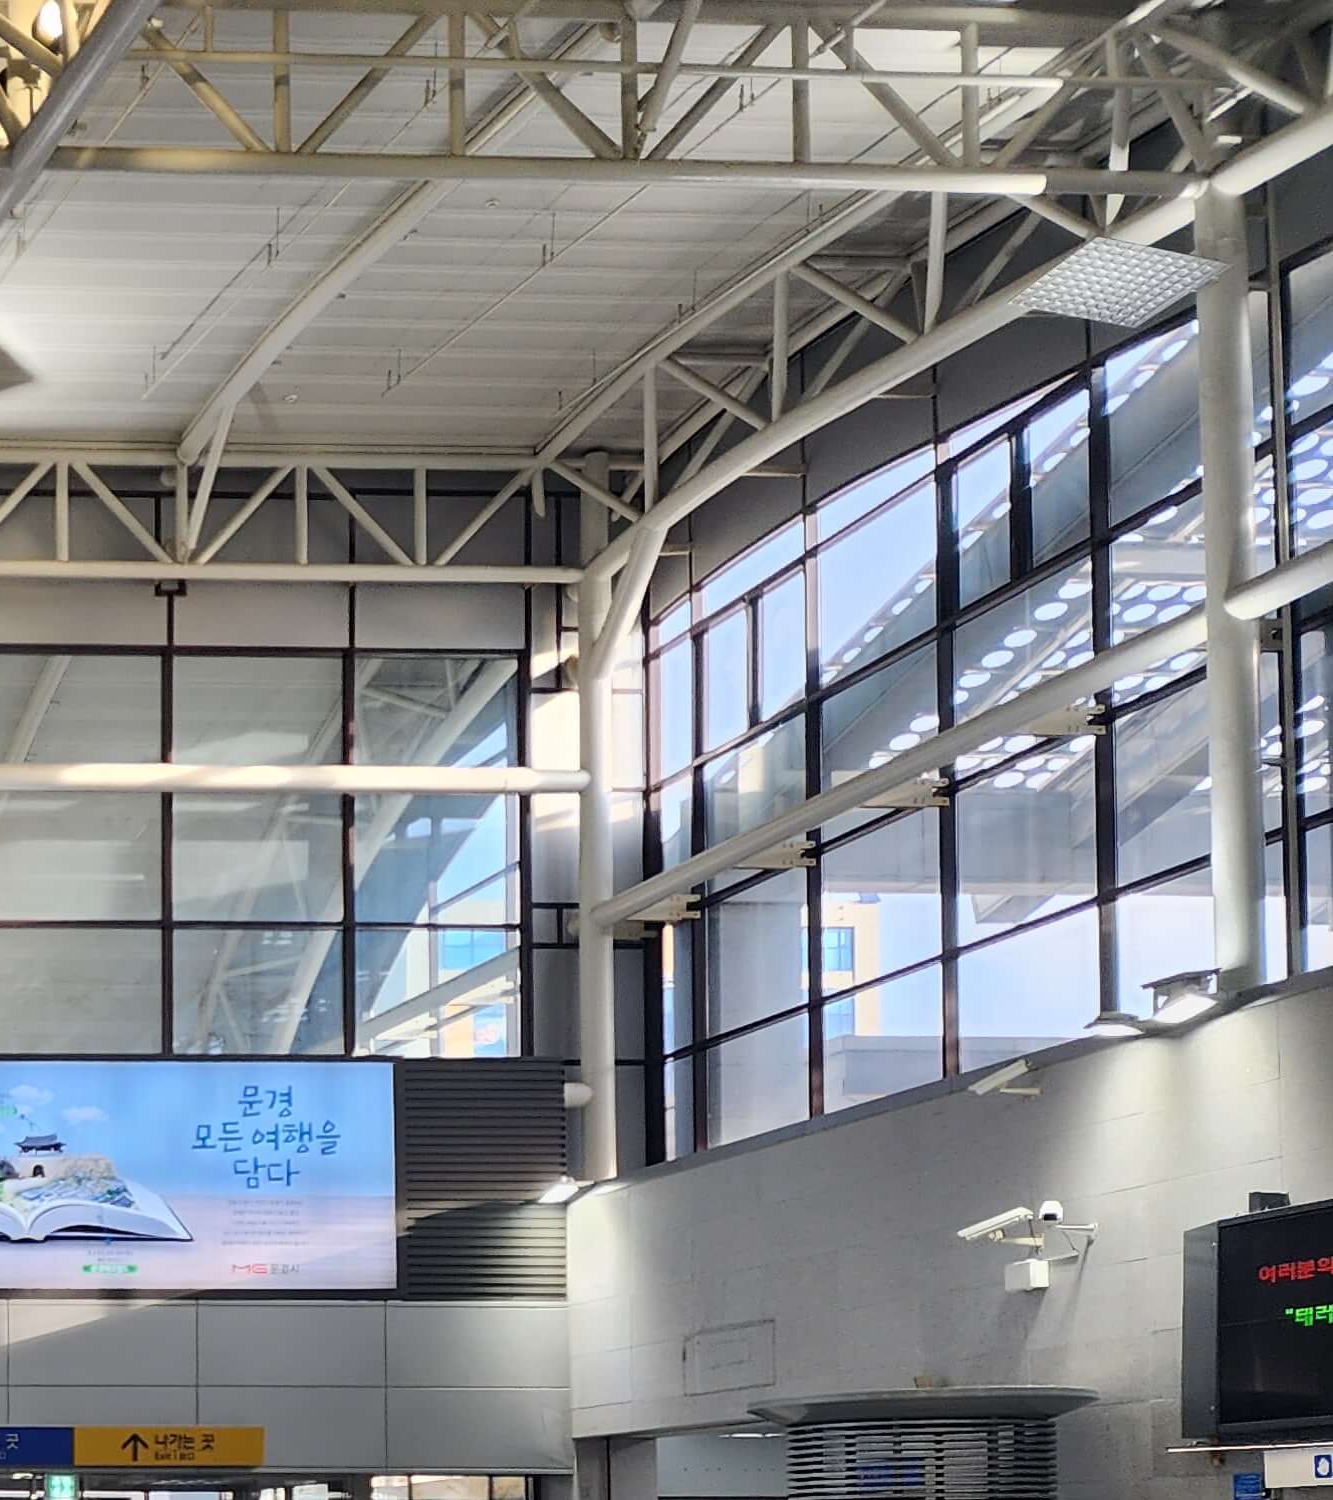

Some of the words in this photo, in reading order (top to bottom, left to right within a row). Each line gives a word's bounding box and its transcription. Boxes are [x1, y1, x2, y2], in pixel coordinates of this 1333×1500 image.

[238, 1085, 294, 1117] 문경
[191, 1121, 244, 1153] 모든
[251, 1120, 342, 1156] 여행을
[233, 1156, 301, 1189] 담다
[5, 1433, 19, 1449] 곳
[154, 1433, 195, 1449] 나가는
[201, 1433, 214, 1450] 곳
